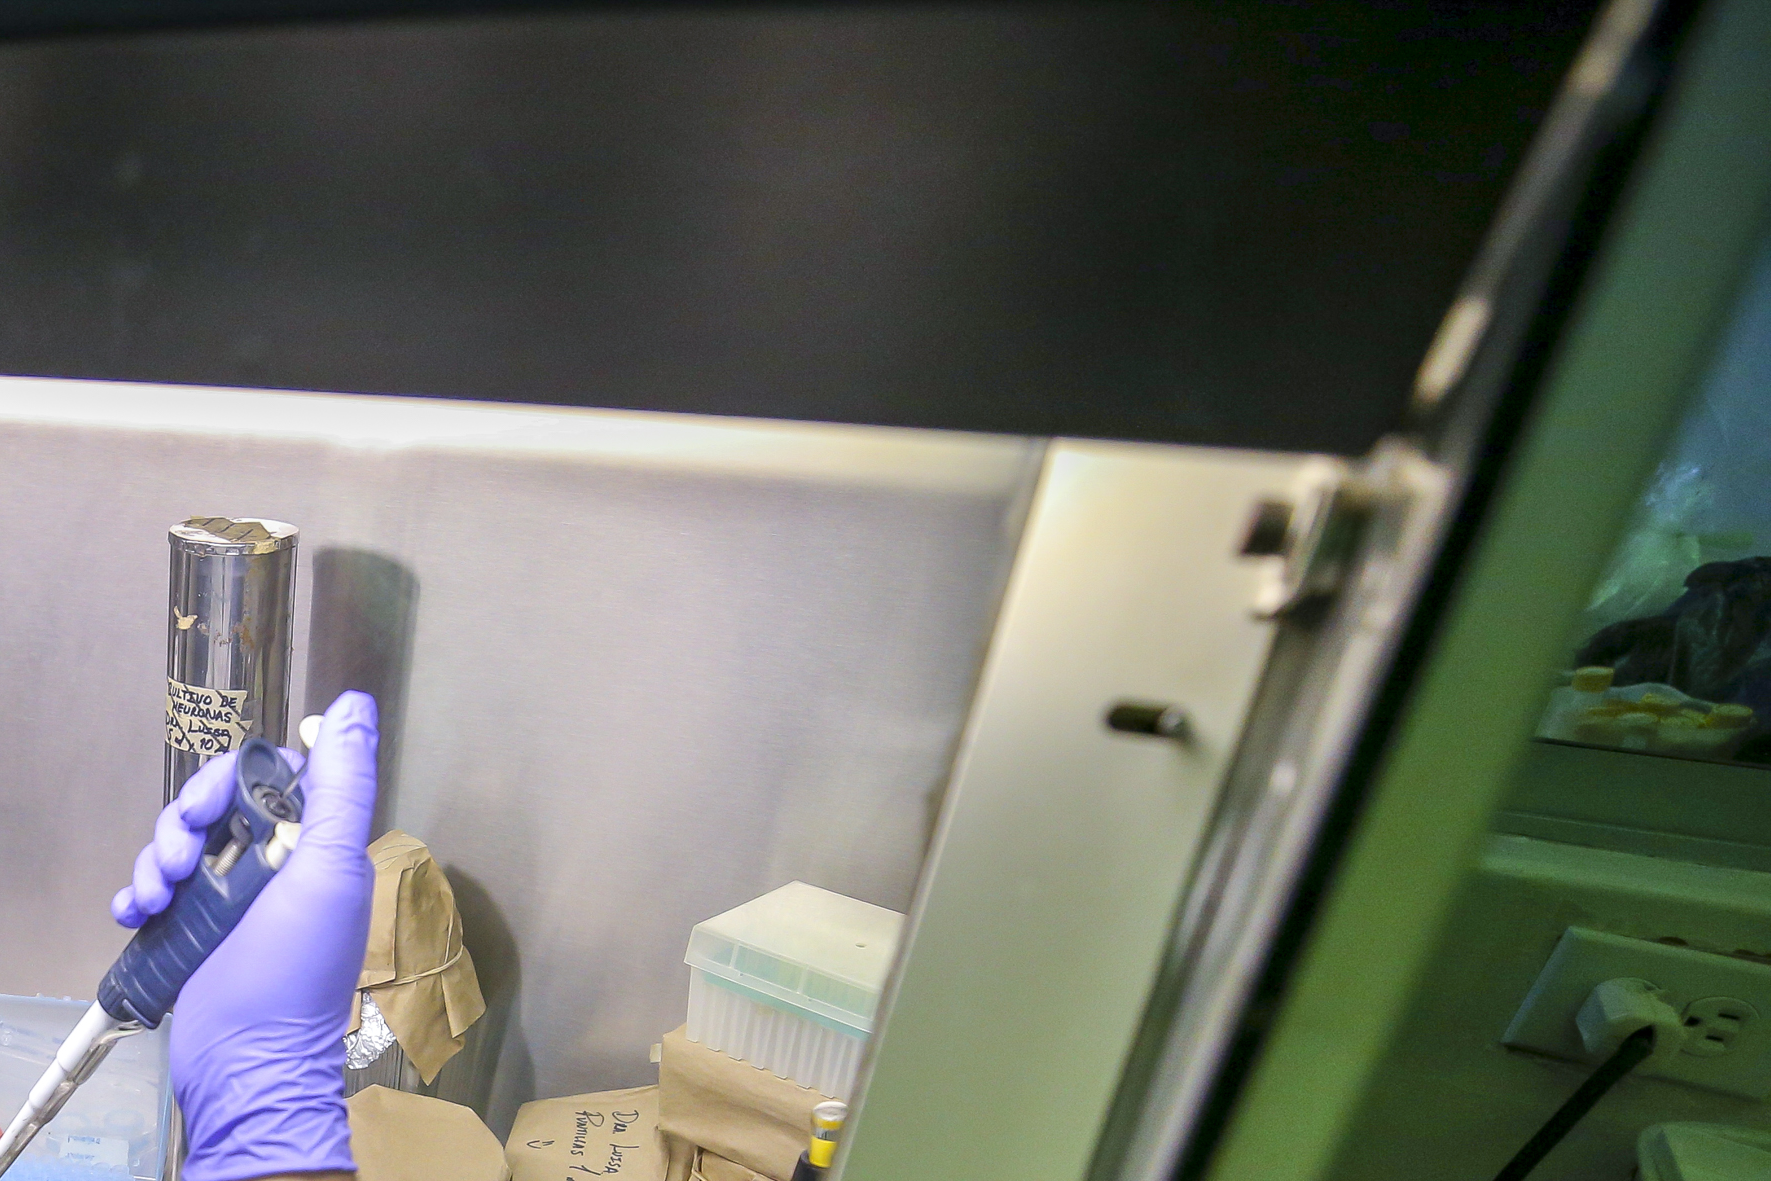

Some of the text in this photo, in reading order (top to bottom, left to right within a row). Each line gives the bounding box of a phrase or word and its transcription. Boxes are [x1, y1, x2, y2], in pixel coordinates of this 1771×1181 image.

[220, 695, 238, 709] DE
[173, 700, 233, 724] NEURONAS
[200, 737, 214, 751] 10
[599, 1143, 640, 1174] LUISA
